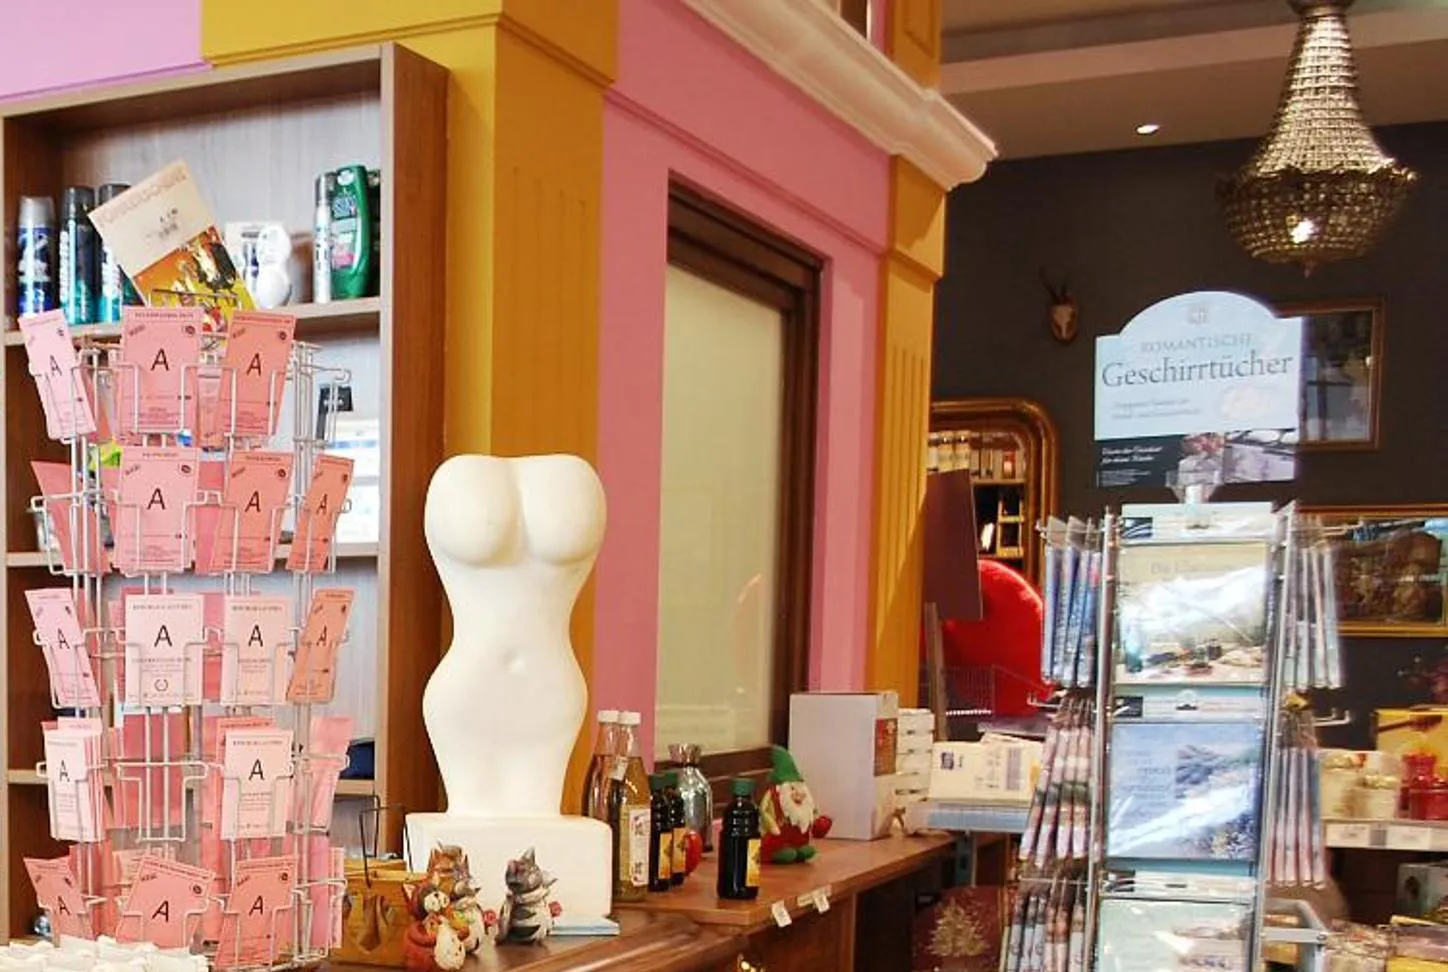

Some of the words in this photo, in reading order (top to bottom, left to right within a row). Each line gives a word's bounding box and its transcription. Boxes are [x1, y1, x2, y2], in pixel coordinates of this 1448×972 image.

[50, 356, 62, 375] A
[151, 349, 168, 371] A
[247, 353, 261, 375] A
[1102, 350, 1293, 388] Geschirrtücher
[147, 488, 165, 509] A
[245, 491, 260, 512] A
[316, 493, 327, 515] A
[57, 627, 70, 650] A
[155, 625, 172, 647] A
[249, 625, 263, 646] A
[316, 626, 327, 646] A
[59, 760, 70, 782] A
[249, 760, 264, 780] A
[59, 895, 70, 914] A
[152, 901, 168, 922] A
[249, 896, 263, 915] A
